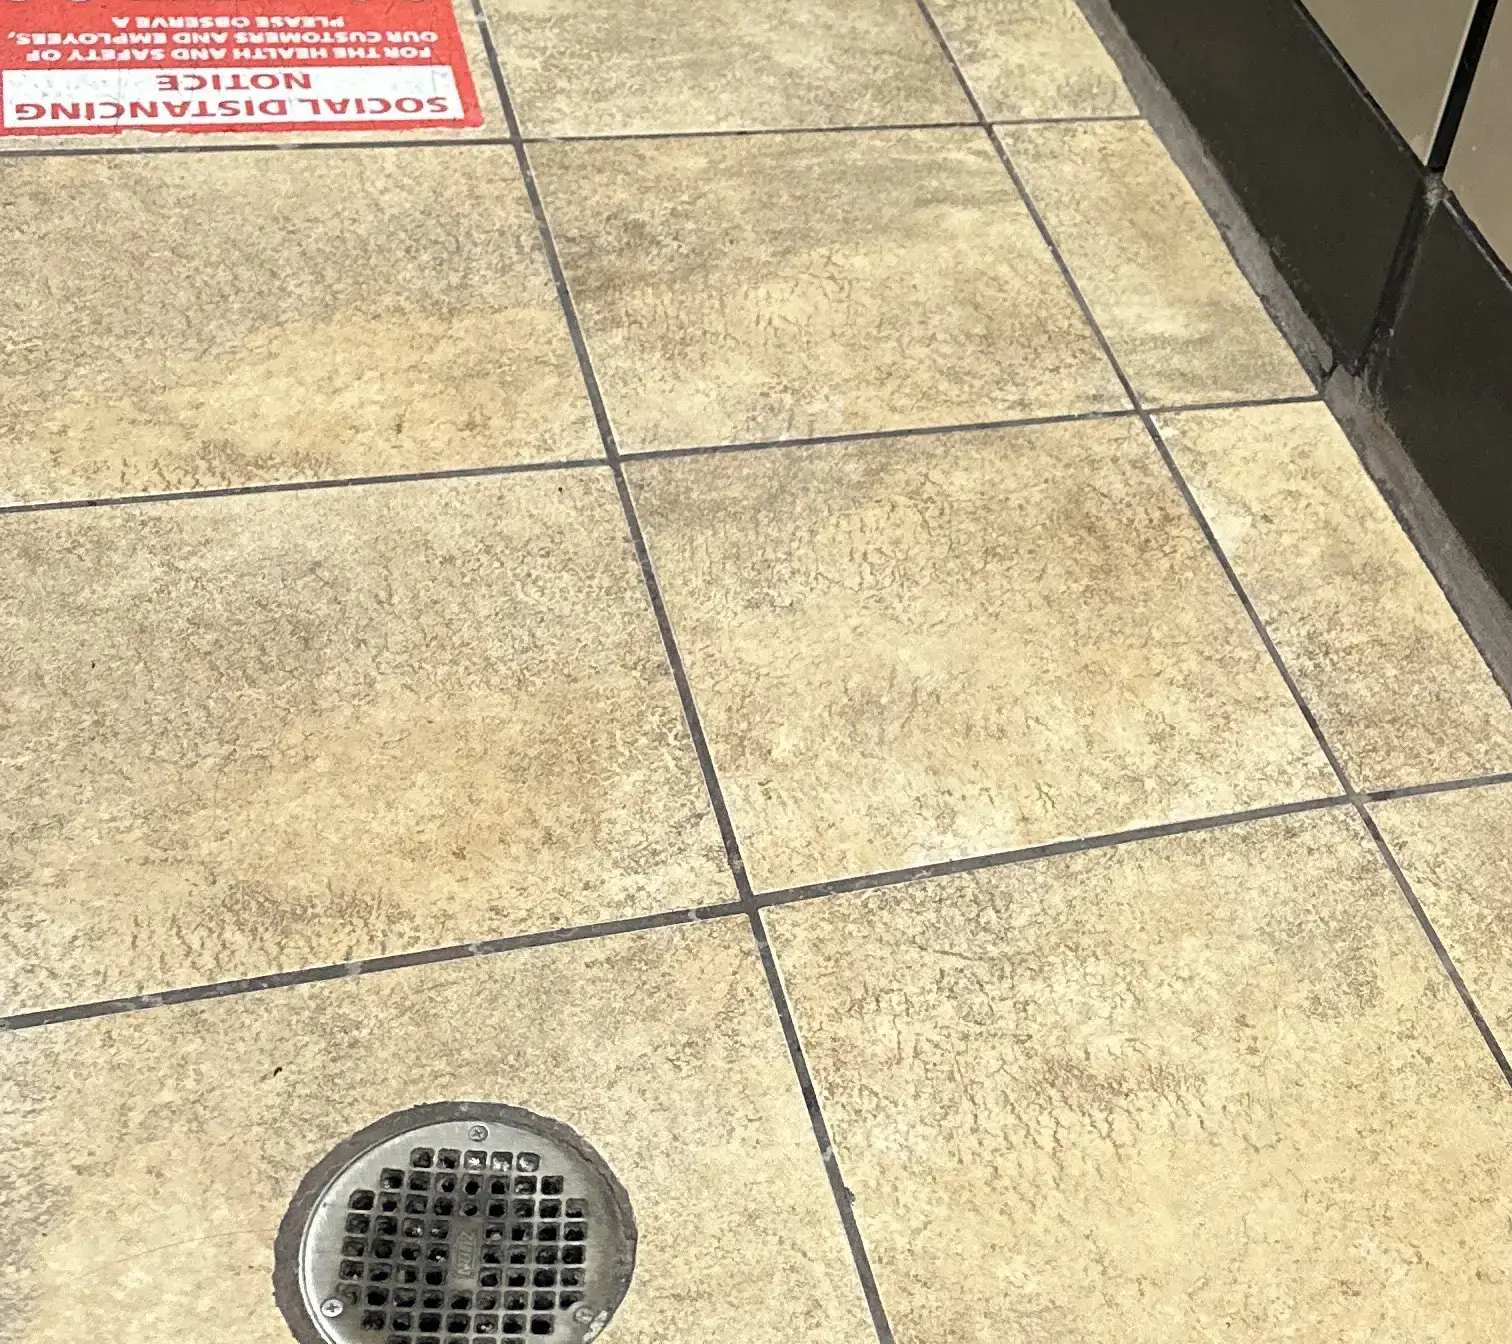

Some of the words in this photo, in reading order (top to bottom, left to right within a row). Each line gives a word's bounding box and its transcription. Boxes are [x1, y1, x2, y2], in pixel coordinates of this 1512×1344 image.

[111, 16, 130, 29] A
[135, 15, 250, 29] OBSERVE
[255, 15, 345, 29] PLEASE
[172, 31, 228, 44] AND
[235, 30, 382, 45] CUSTOMERS
[386, 30, 439, 44] OUR
[25, 48, 62, 63] OF
[67, 48, 166, 62] SAFETY
[171, 48, 228, 61] AND
[232, 46, 328, 61] HEALTH
[333, 46, 381, 60] THE
[383, 46, 432, 59] FOR
[156, 72, 312, 91] NOTICE
[14, 98, 288, 121] DISTANCING
[297, 96, 450, 115] SOCIAL
